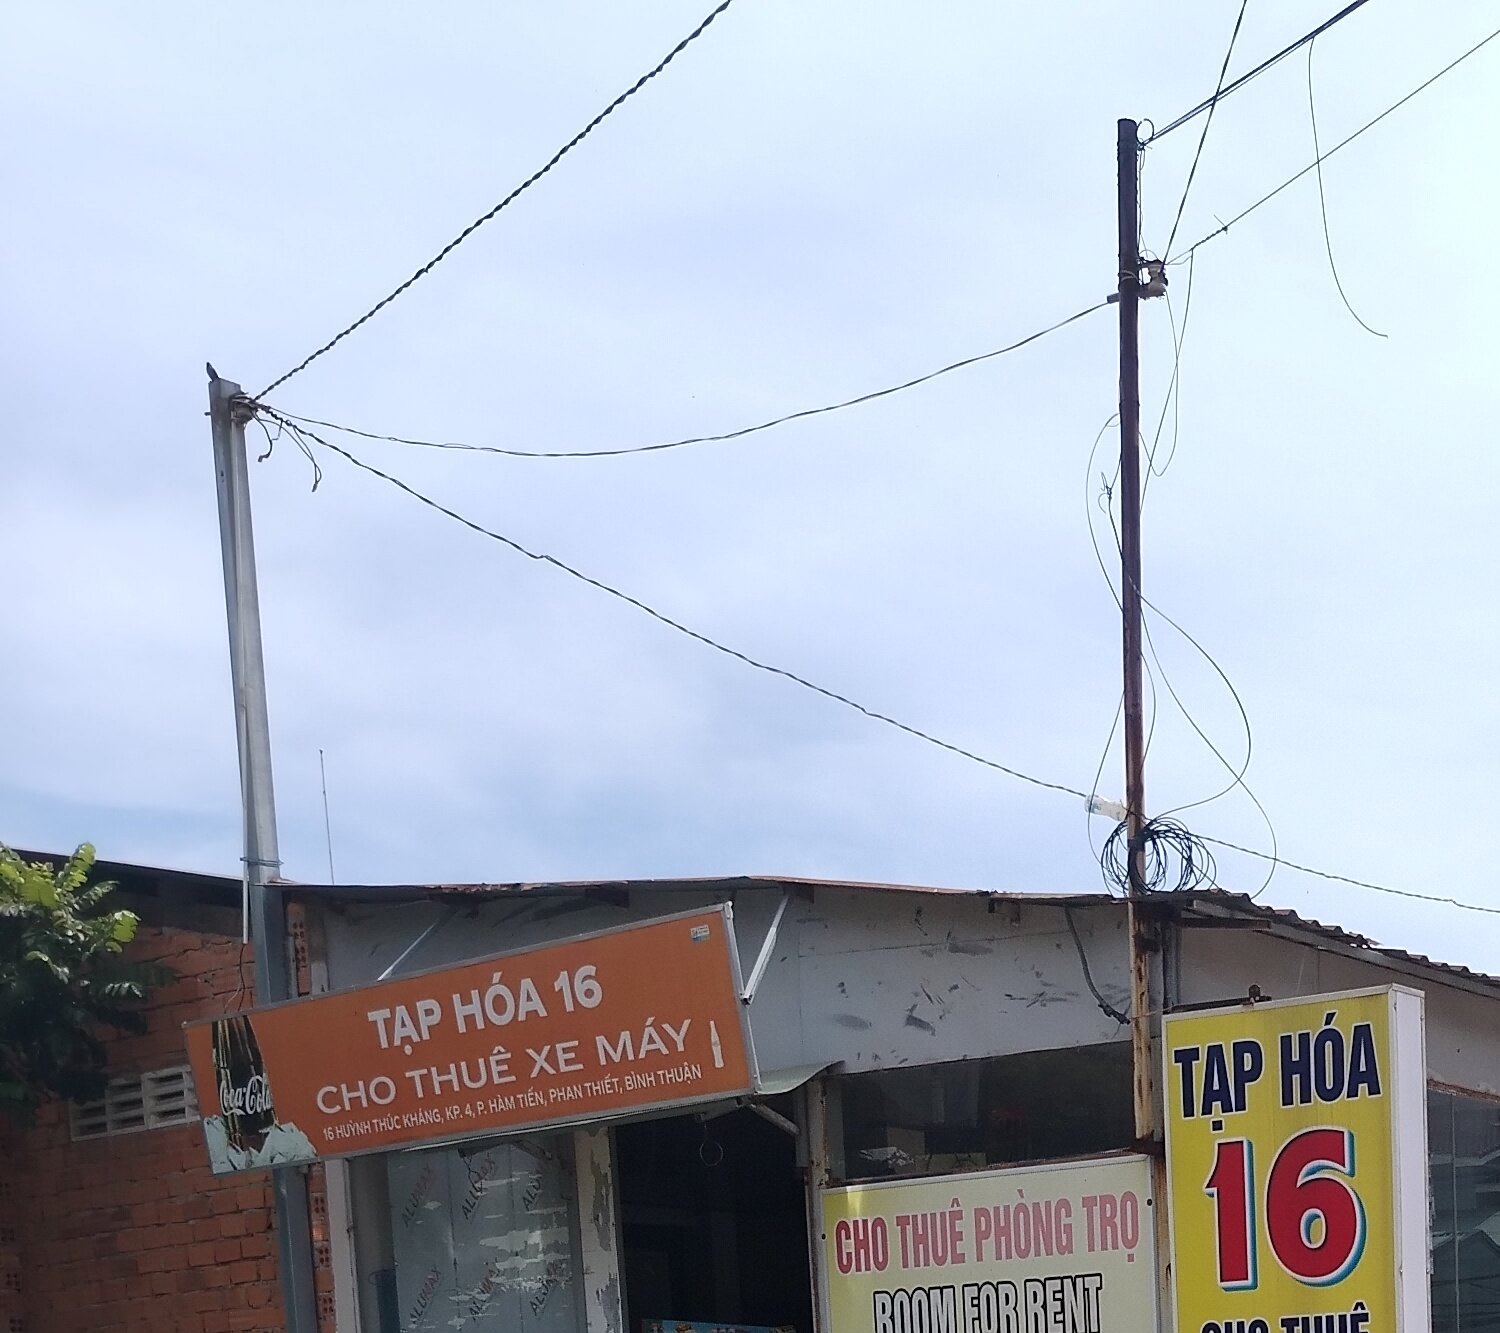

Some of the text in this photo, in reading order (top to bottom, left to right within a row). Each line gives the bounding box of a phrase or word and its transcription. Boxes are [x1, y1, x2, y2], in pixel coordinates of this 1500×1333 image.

[367, 965, 603, 1055] TẠP HÓA 16
[316, 1017, 692, 1116] CHO THUÊ XE MÁY
[323, 1126, 334, 1141] 16
[372, 1113, 402, 1132] THÚC
[489, 1093, 515, 1112] HÀM
[549, 1084, 583, 1102] PHAN
[625, 1070, 656, 1090] BÌNH
[656, 1062, 702, 1085] THUẬN
[1173, 1011, 1382, 1132] TẠP HÓA
[835, 1189, 1140, 1275] CHO THUÊ PHÒNG TRỌ
[1205, 1127, 1367, 1292] 16
